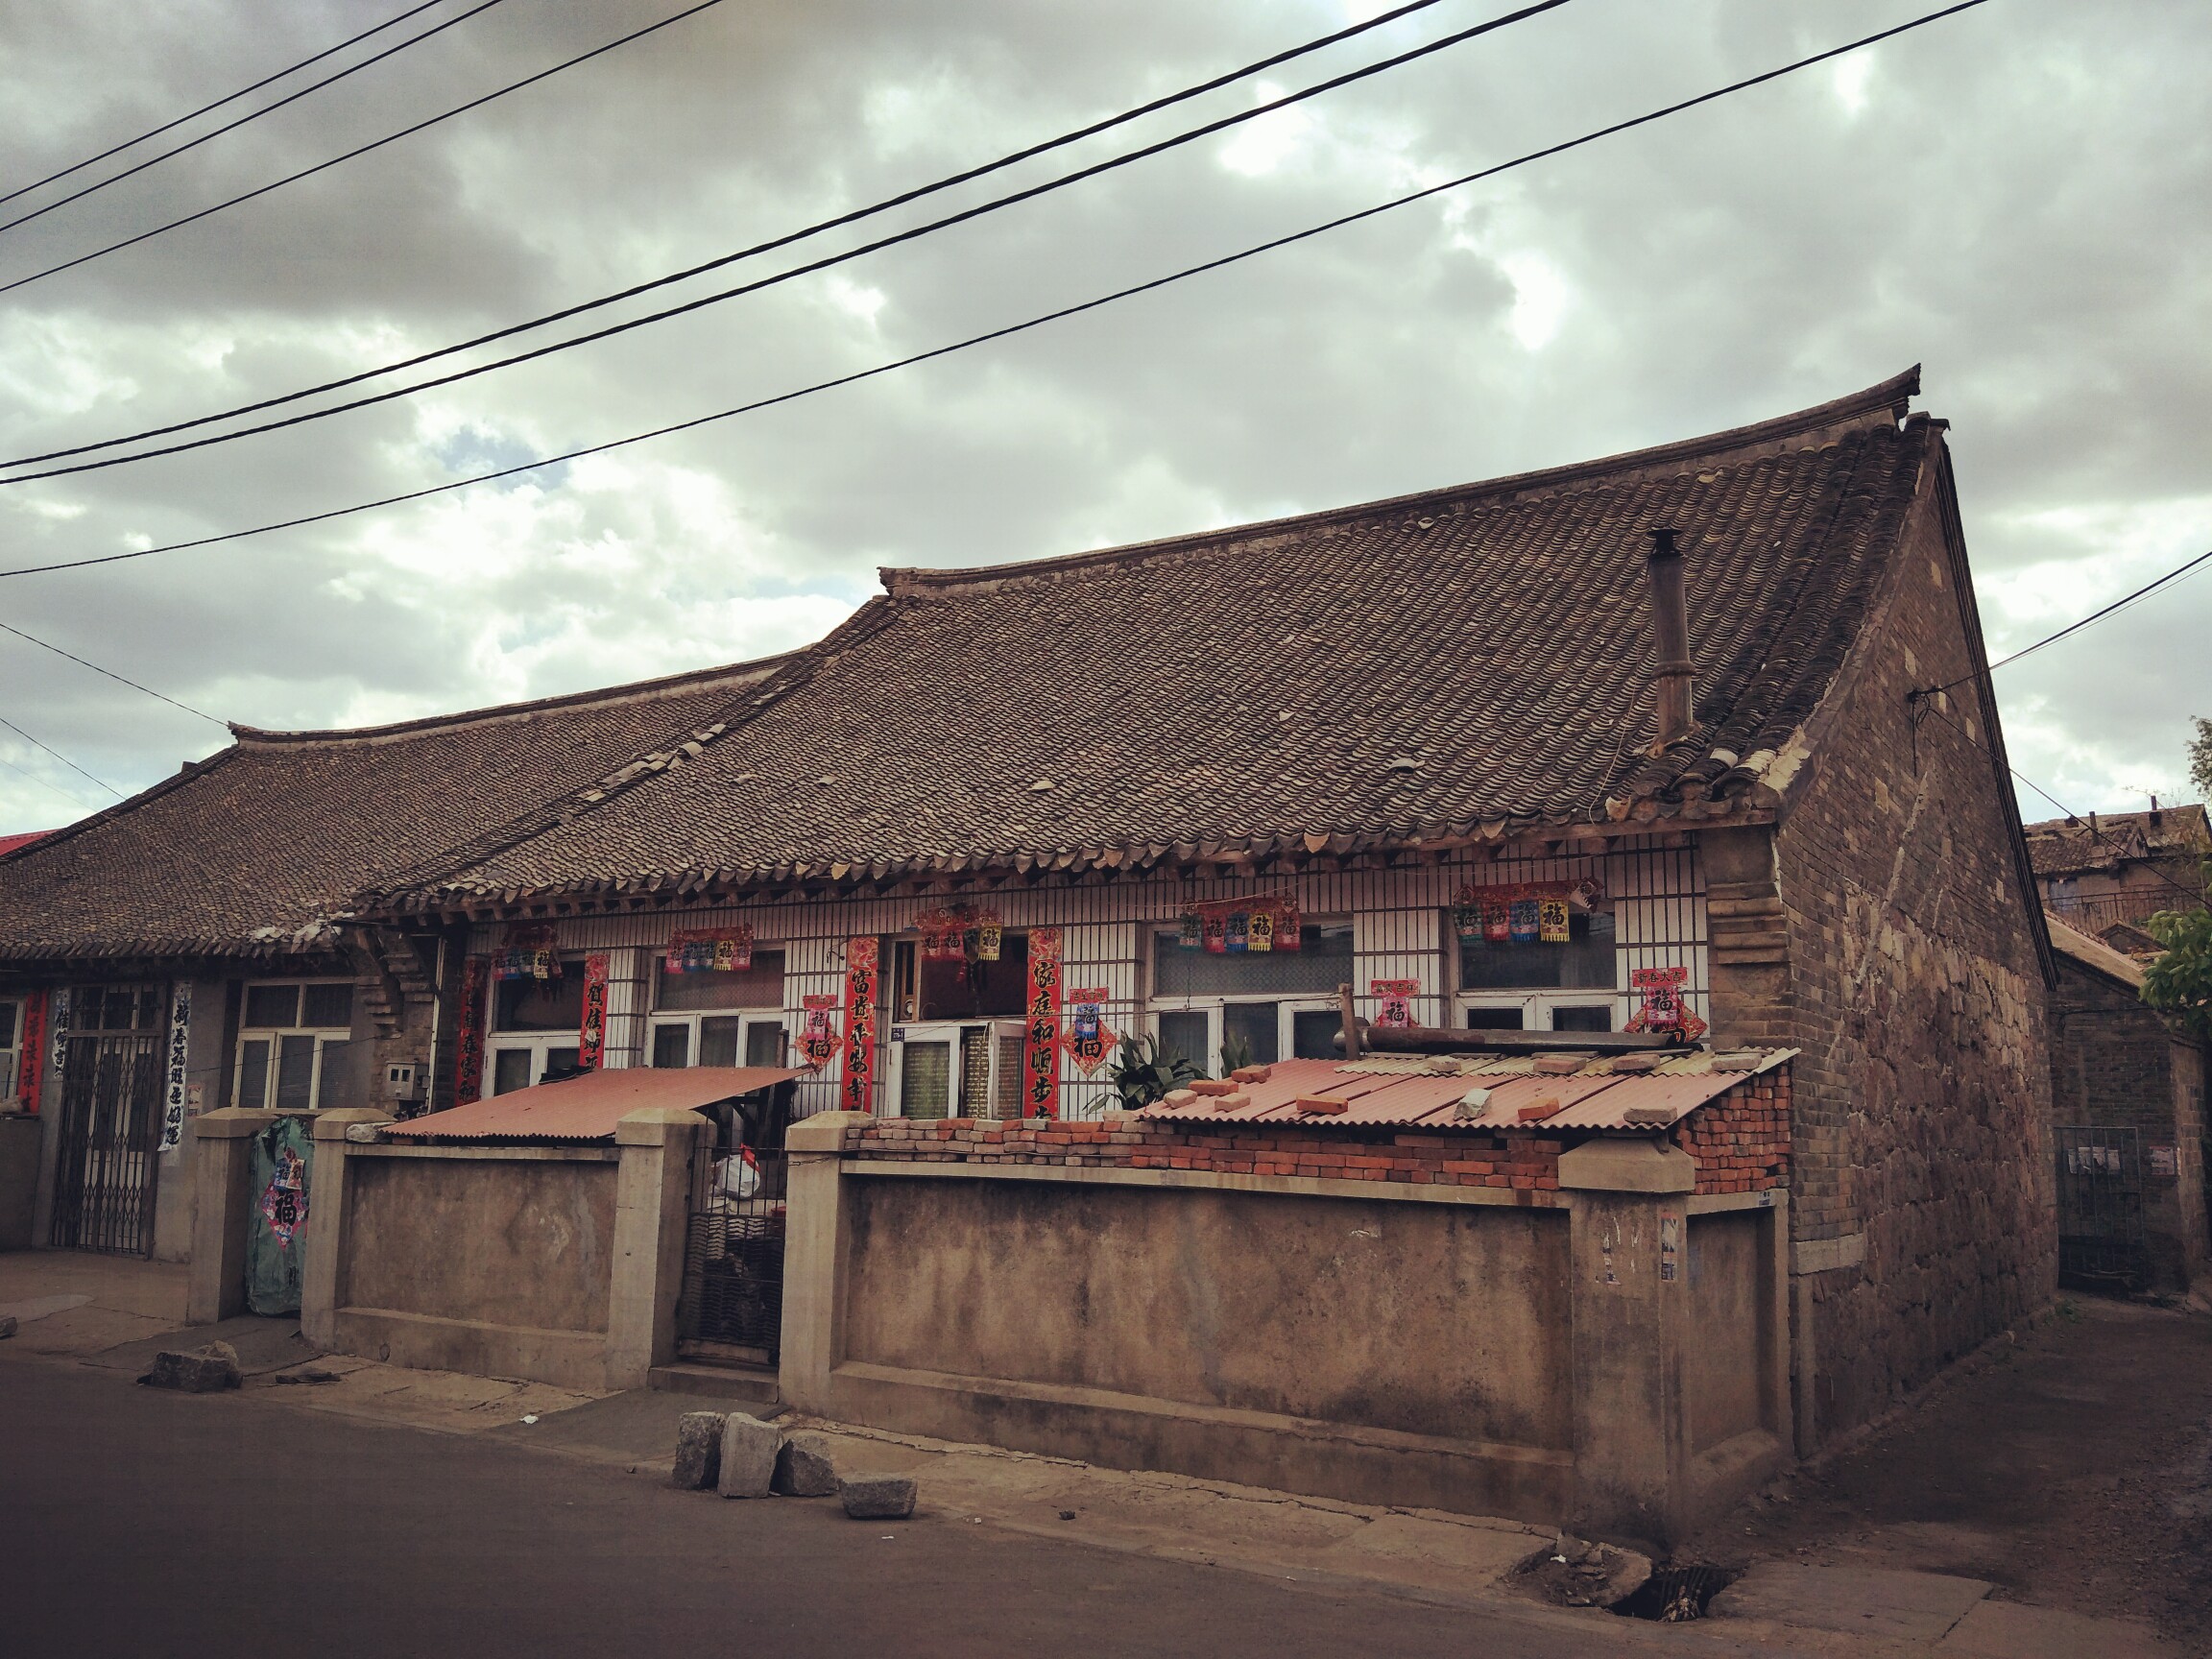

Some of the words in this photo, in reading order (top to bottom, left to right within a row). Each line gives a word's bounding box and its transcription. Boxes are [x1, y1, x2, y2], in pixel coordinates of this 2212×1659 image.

[1542, 903, 1565, 925] 福
[1208, 918, 1223, 937] 福
[1252, 915, 1271, 935] 福
[983, 929, 999, 948] 福
[718, 942, 733, 957] 福
[1638, 971, 1682, 984] 新春大吉
[1651, 988, 1673, 1011] 福
[812, 1010, 825, 1027] 福
[1385, 1000, 1406, 1022] 福
[847, 969, 873, 1109] 富貴平安年
[275, 1190, 298, 1227] 福
